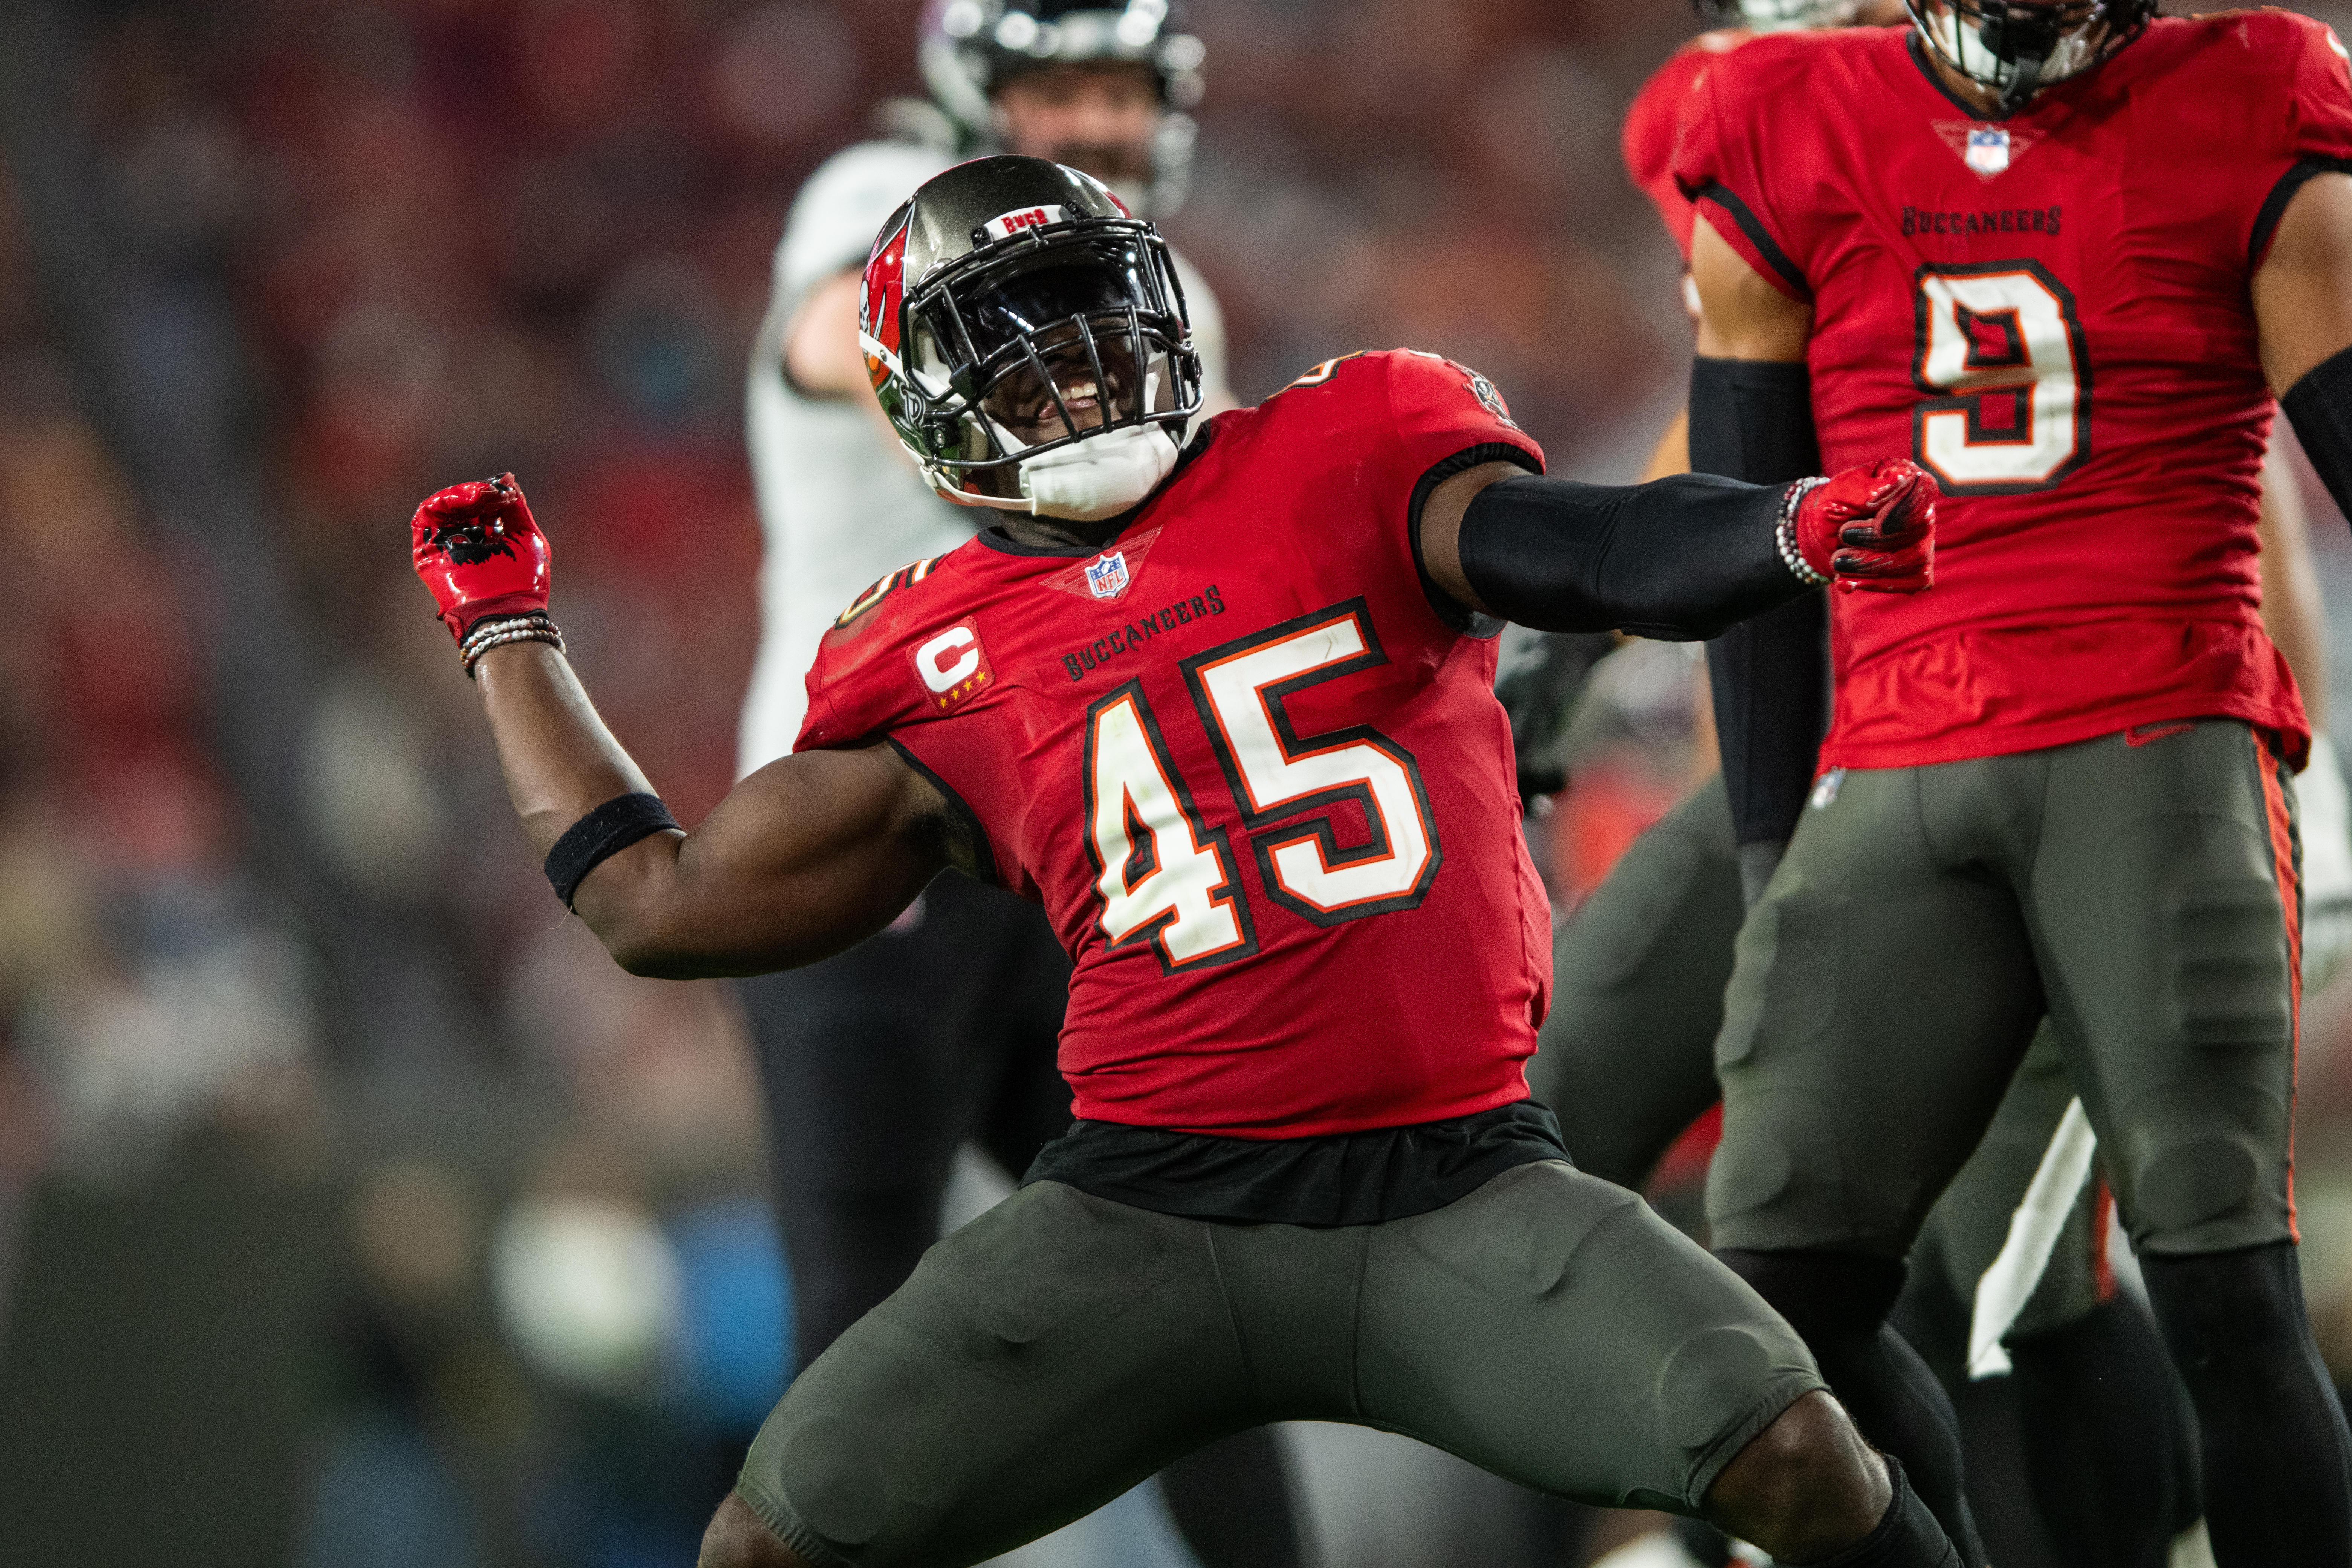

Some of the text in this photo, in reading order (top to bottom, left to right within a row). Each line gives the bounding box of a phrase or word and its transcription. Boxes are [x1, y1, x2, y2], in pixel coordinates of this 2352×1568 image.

[1901, 205, 2062, 240] BUCCANEERS
[1910, 257, 2093, 497] 9
[1096, 570, 1124, 592] NFL
[916, 626, 979, 693] C
[1061, 585, 1225, 682] BUCCANEERS
[1082, 595, 1444, 977] 45
